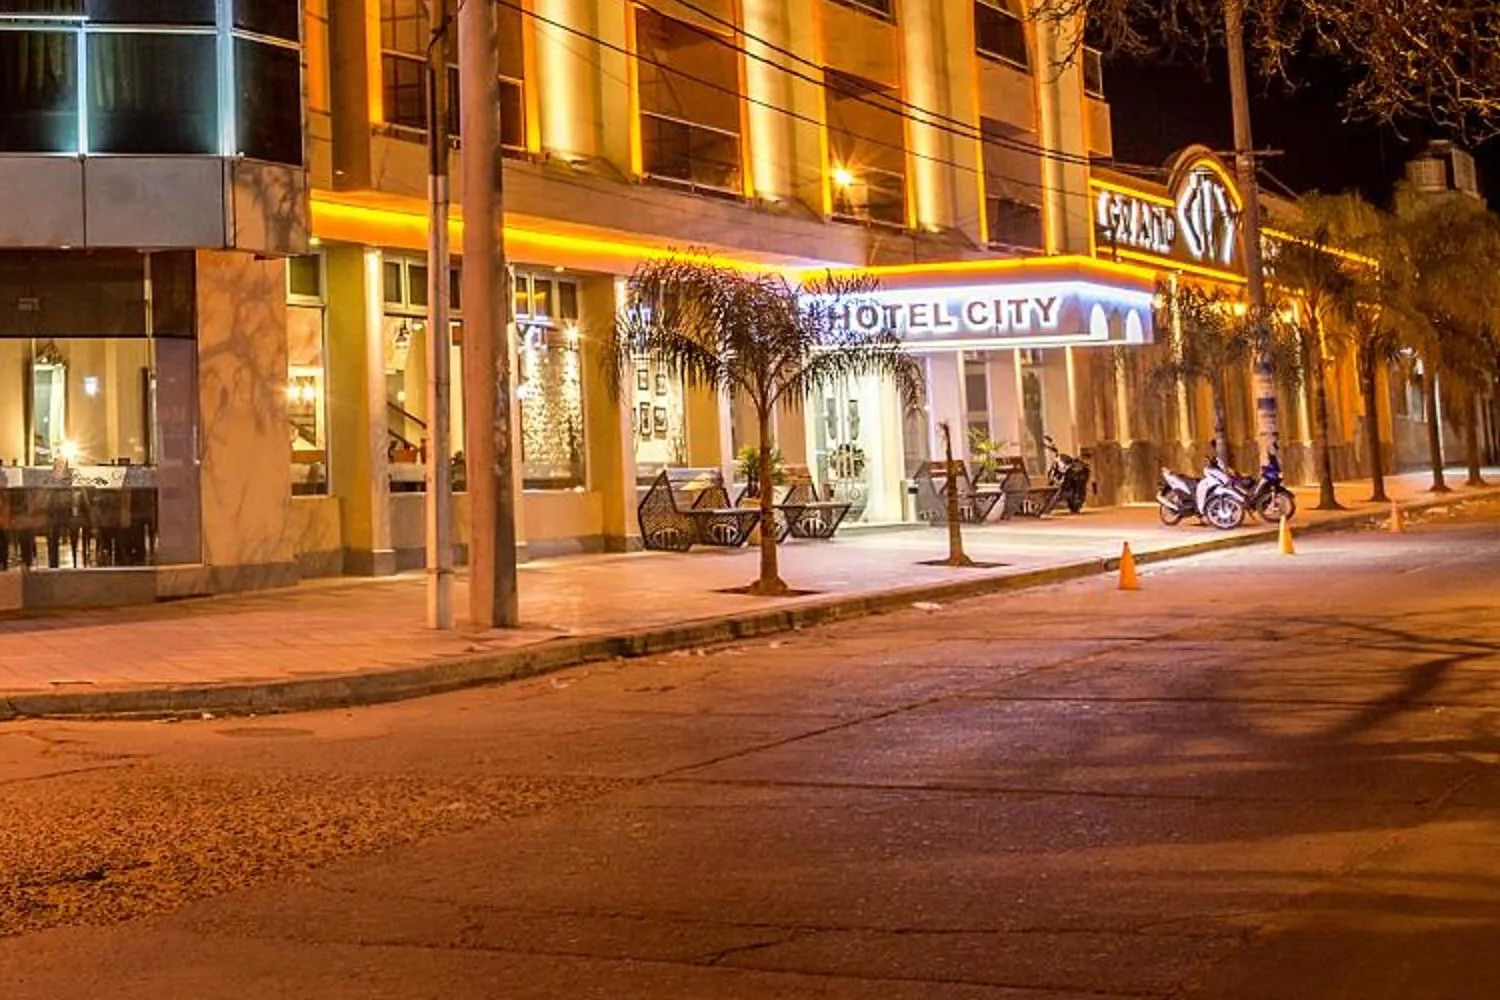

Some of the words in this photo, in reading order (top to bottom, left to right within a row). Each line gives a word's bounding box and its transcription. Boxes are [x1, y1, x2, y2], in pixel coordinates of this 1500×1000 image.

[1096, 189, 1175, 254] GRAND
[828, 303, 952, 329] HOTEL
[966, 296, 1057, 327] CITY
